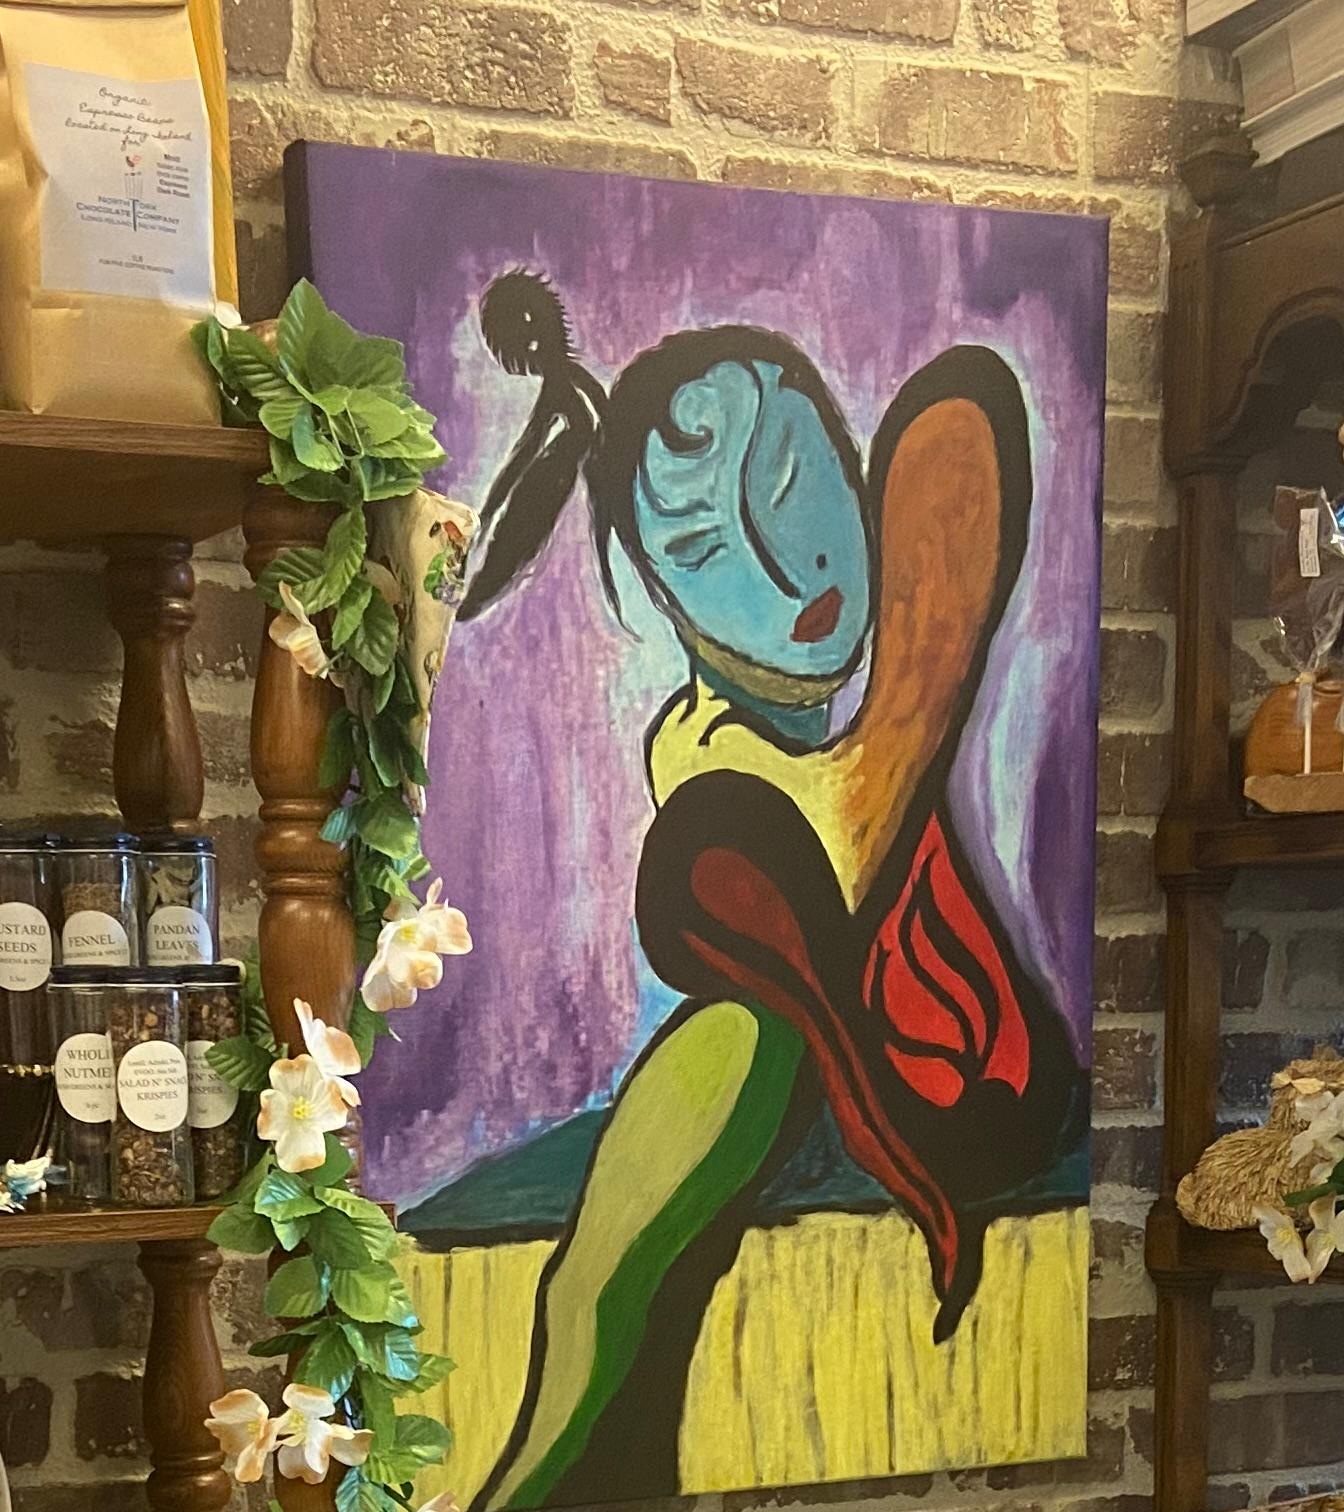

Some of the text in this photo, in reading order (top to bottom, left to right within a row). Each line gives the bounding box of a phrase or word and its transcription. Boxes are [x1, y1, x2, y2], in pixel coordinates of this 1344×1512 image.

[79, 103, 135, 121] Espresso
[76, 202, 130, 217] CHOCOLATE
[154, 923, 200, 935] PANDAN
[68, 933, 116, 948] FENNEL
[155, 939, 199, 951] LEAVES
[119, 1078, 150, 1089] SALAD
[137, 1090, 179, 1102] KRISPIES
